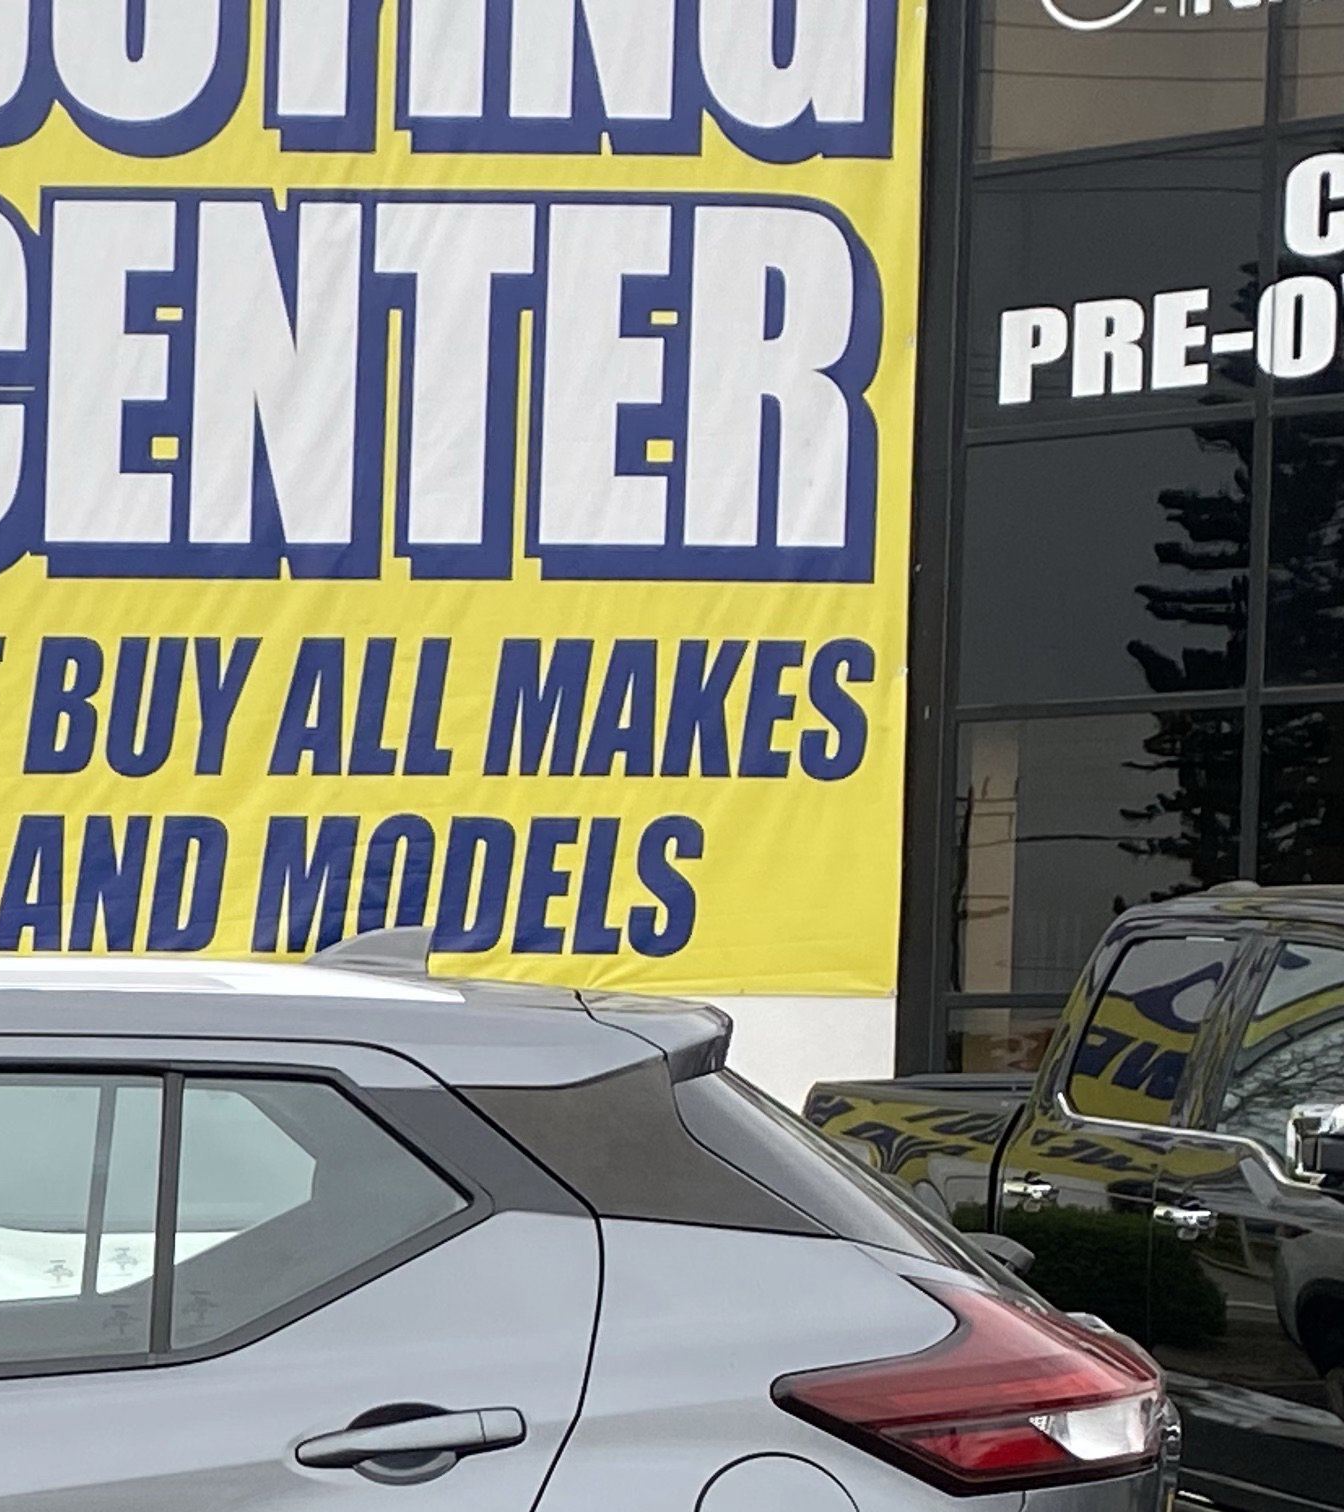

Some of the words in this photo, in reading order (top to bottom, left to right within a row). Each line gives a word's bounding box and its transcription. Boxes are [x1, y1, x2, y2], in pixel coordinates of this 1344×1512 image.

[998, 275, 1344, 405] PRE-O
[23, 636, 263, 777] BUY
[268, 636, 452, 777] ALL
[484, 638, 875, 782] MAKES
[250, 813, 704, 958] MODELS
